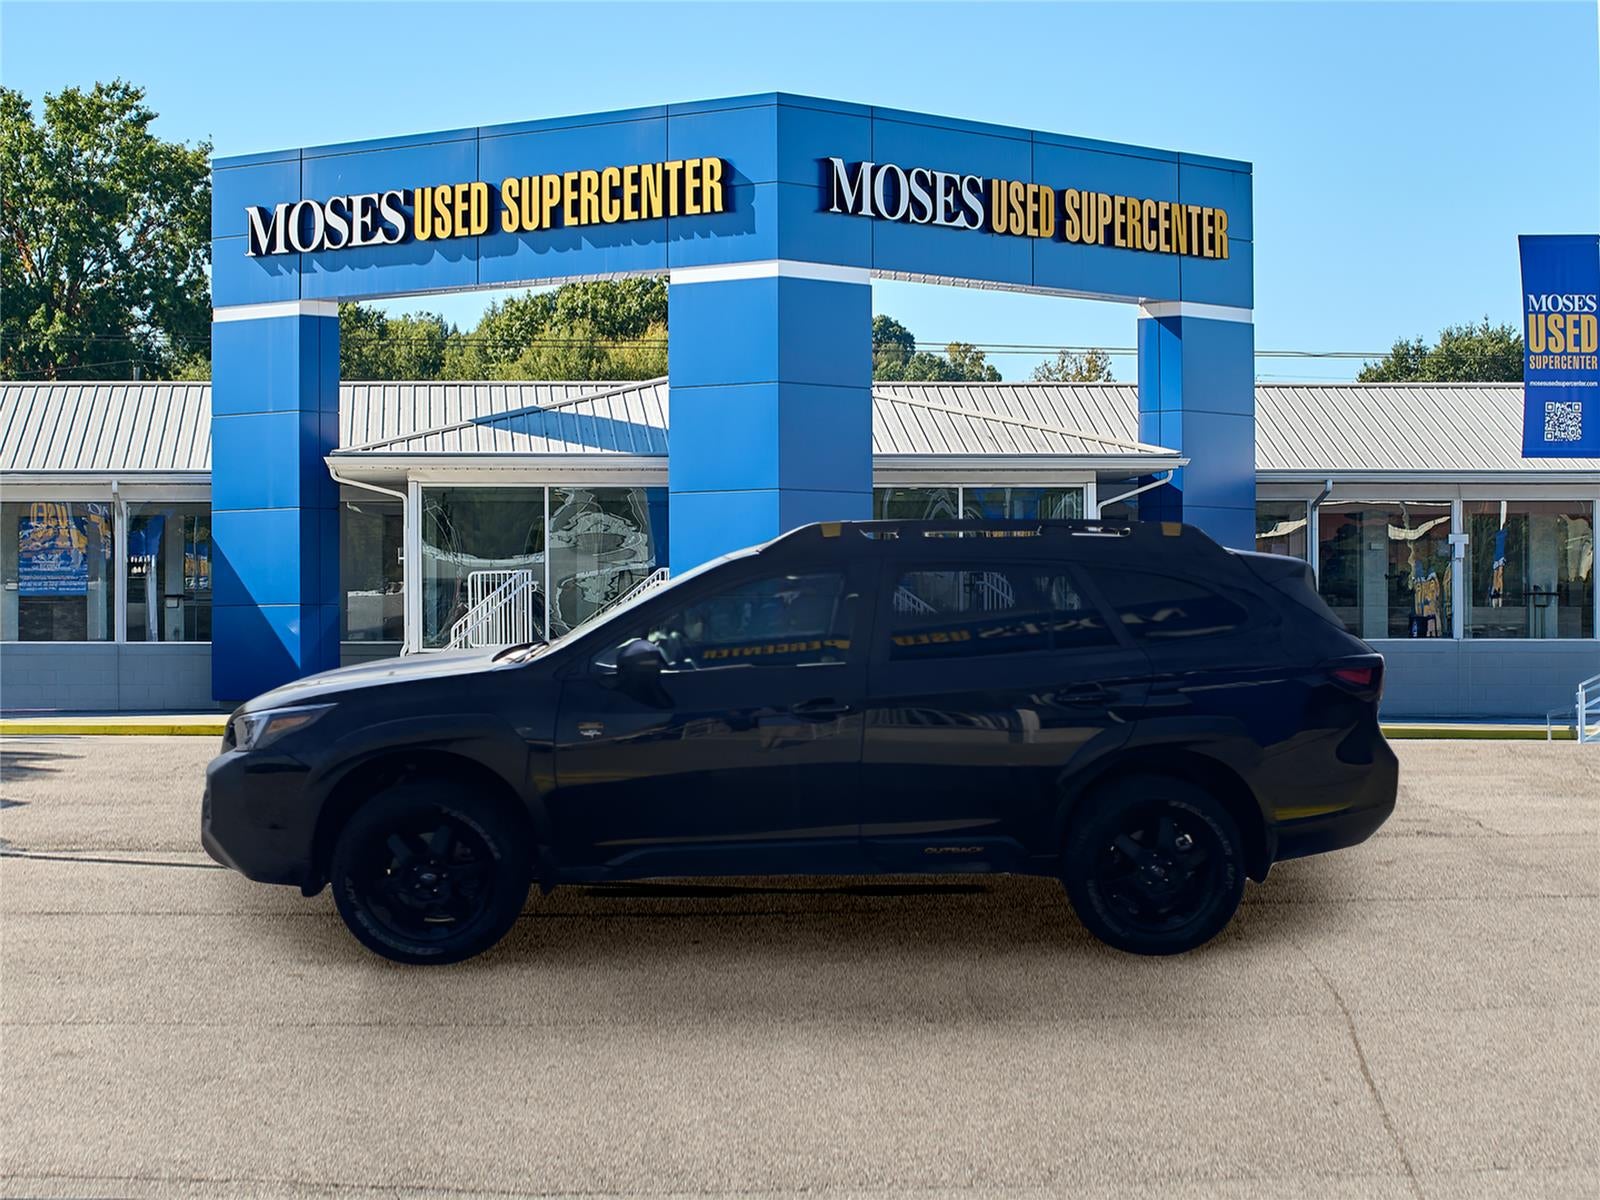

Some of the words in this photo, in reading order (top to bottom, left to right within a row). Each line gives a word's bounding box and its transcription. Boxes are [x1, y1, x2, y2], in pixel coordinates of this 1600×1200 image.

[245, 189, 406, 257] MOSES
[414, 181, 489, 242] USED
[501, 156, 725, 233] SUPERCENTER
[828, 157, 985, 231] MOSES
[991, 178, 1055, 238] USED
[1065, 188, 1230, 260] SUPERCENTER
[1527, 294, 1597, 313] MOSES
[1528, 313, 1598, 354] USED
[1529, 355, 1598, 370] SUPERCENTER
